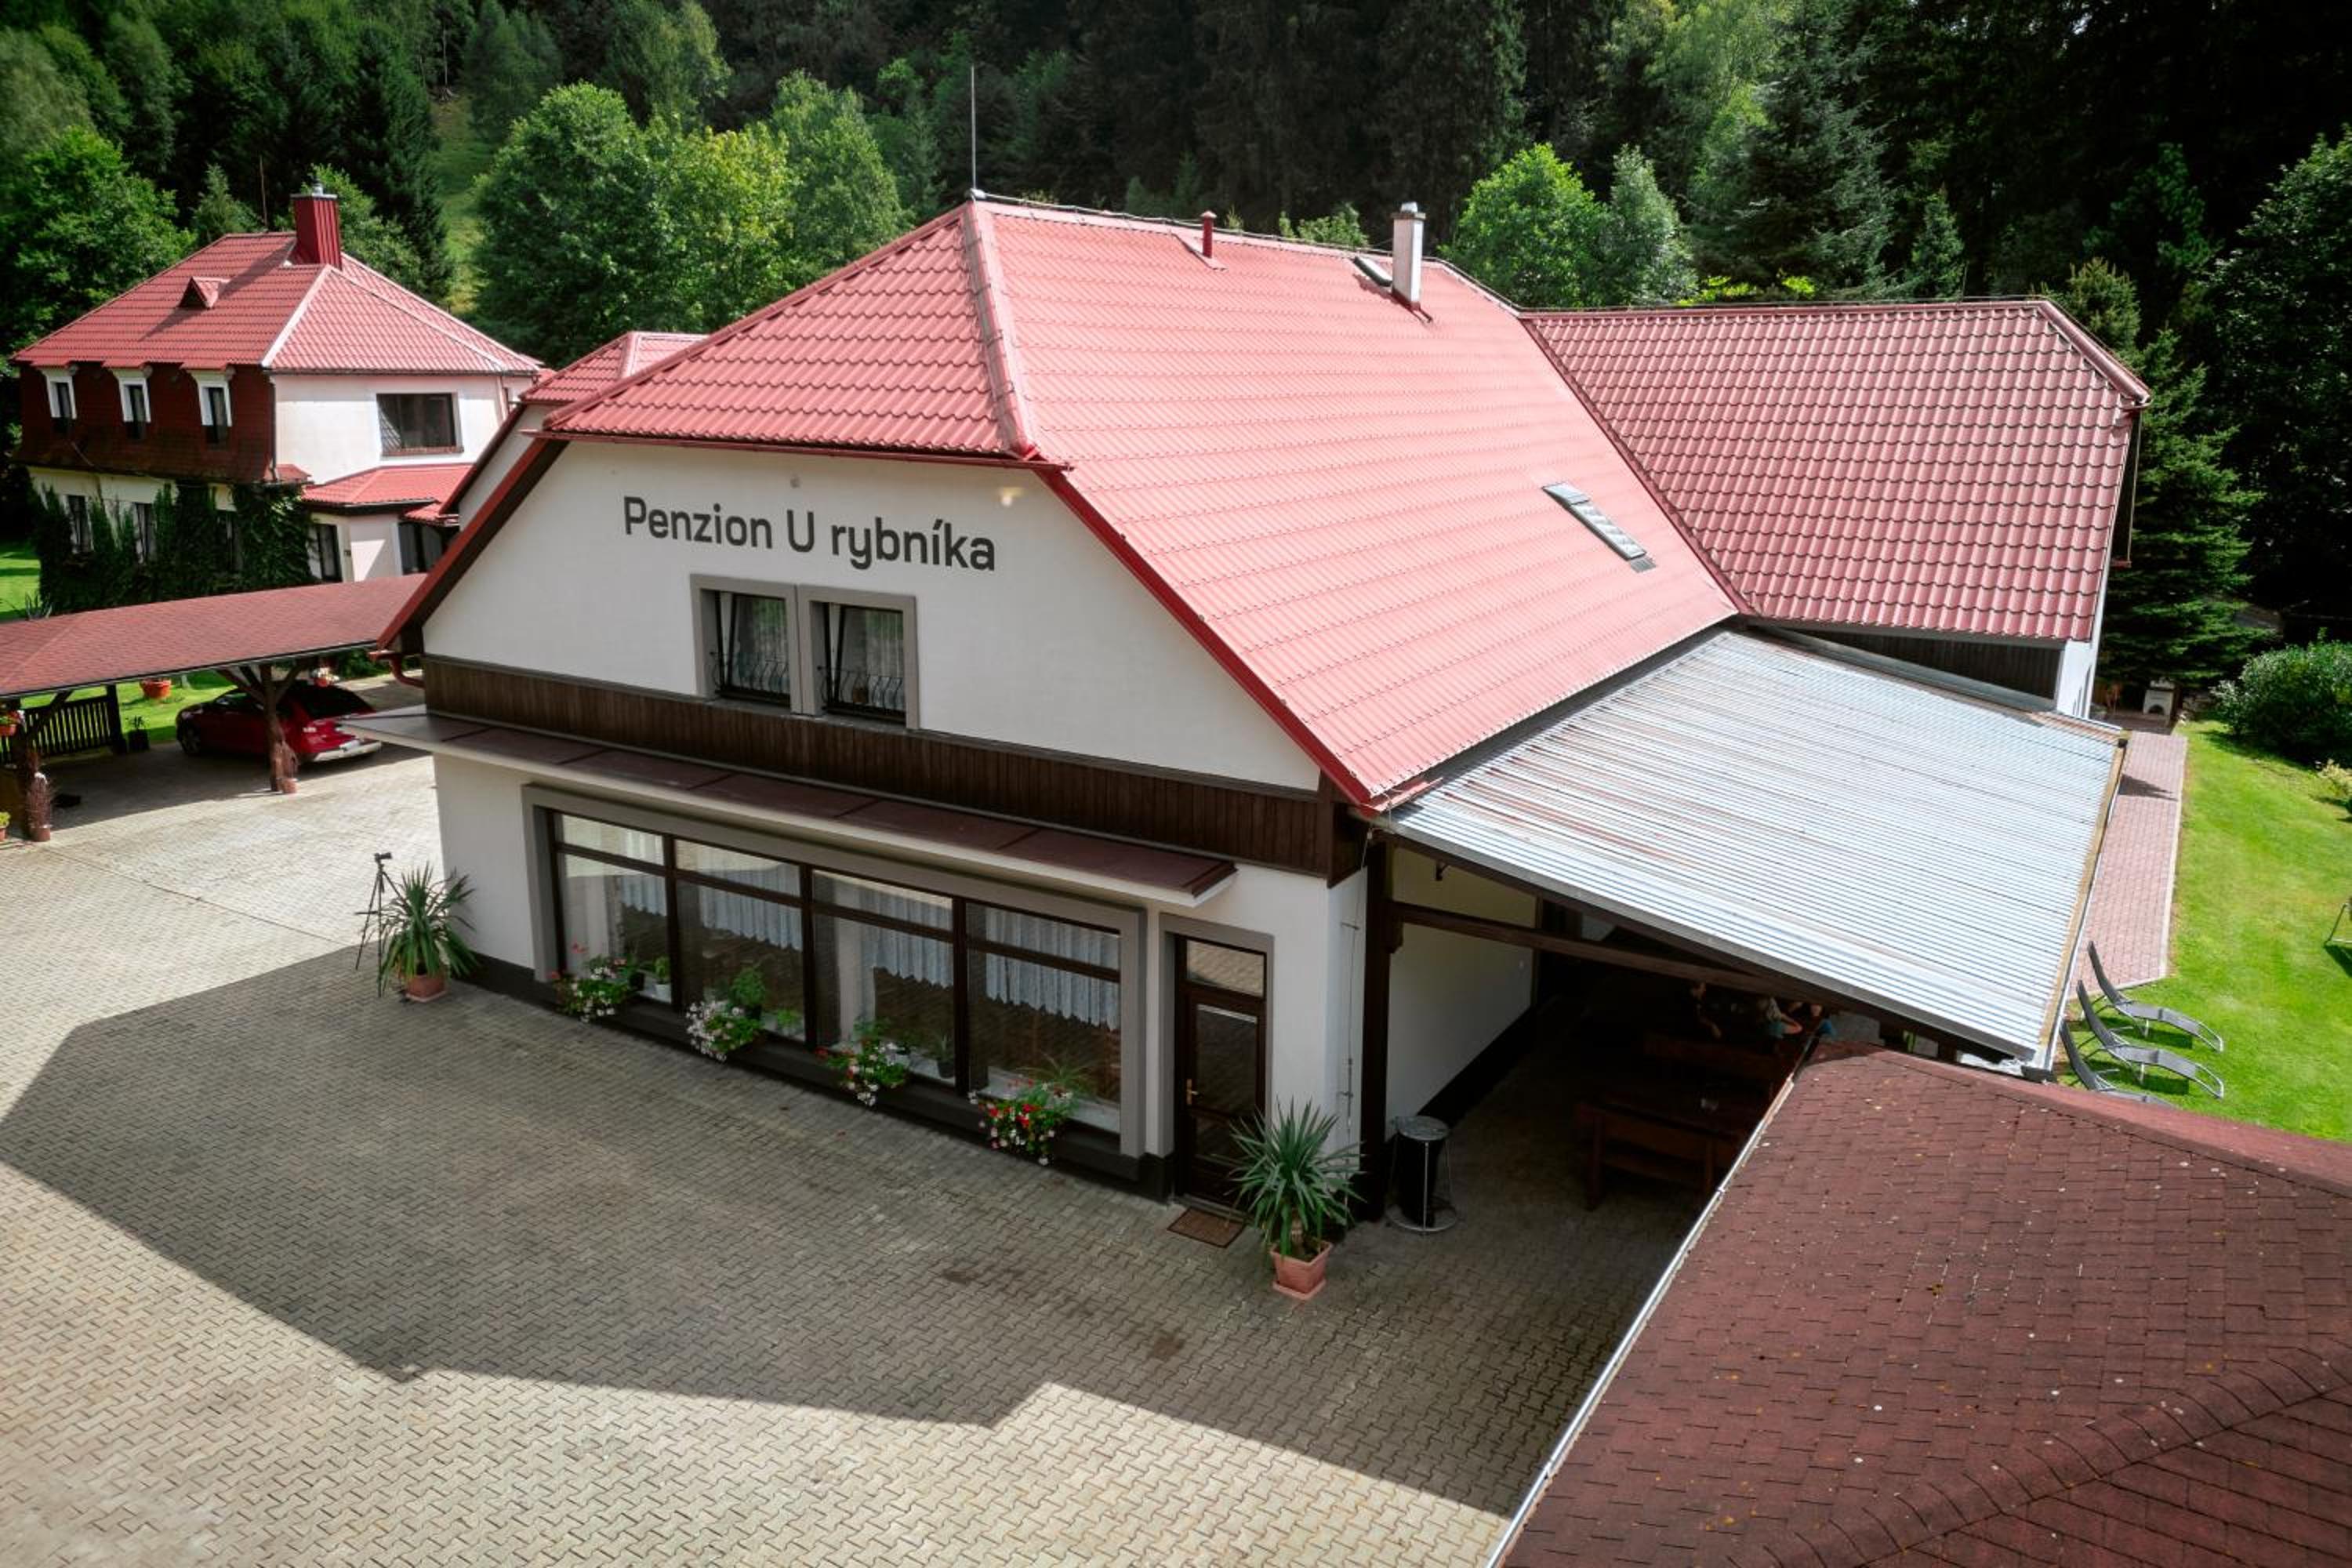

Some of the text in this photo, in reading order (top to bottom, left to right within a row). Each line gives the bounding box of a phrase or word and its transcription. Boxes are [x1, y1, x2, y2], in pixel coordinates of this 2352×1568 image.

[623, 495, 995, 572] Penzion U rybníka
